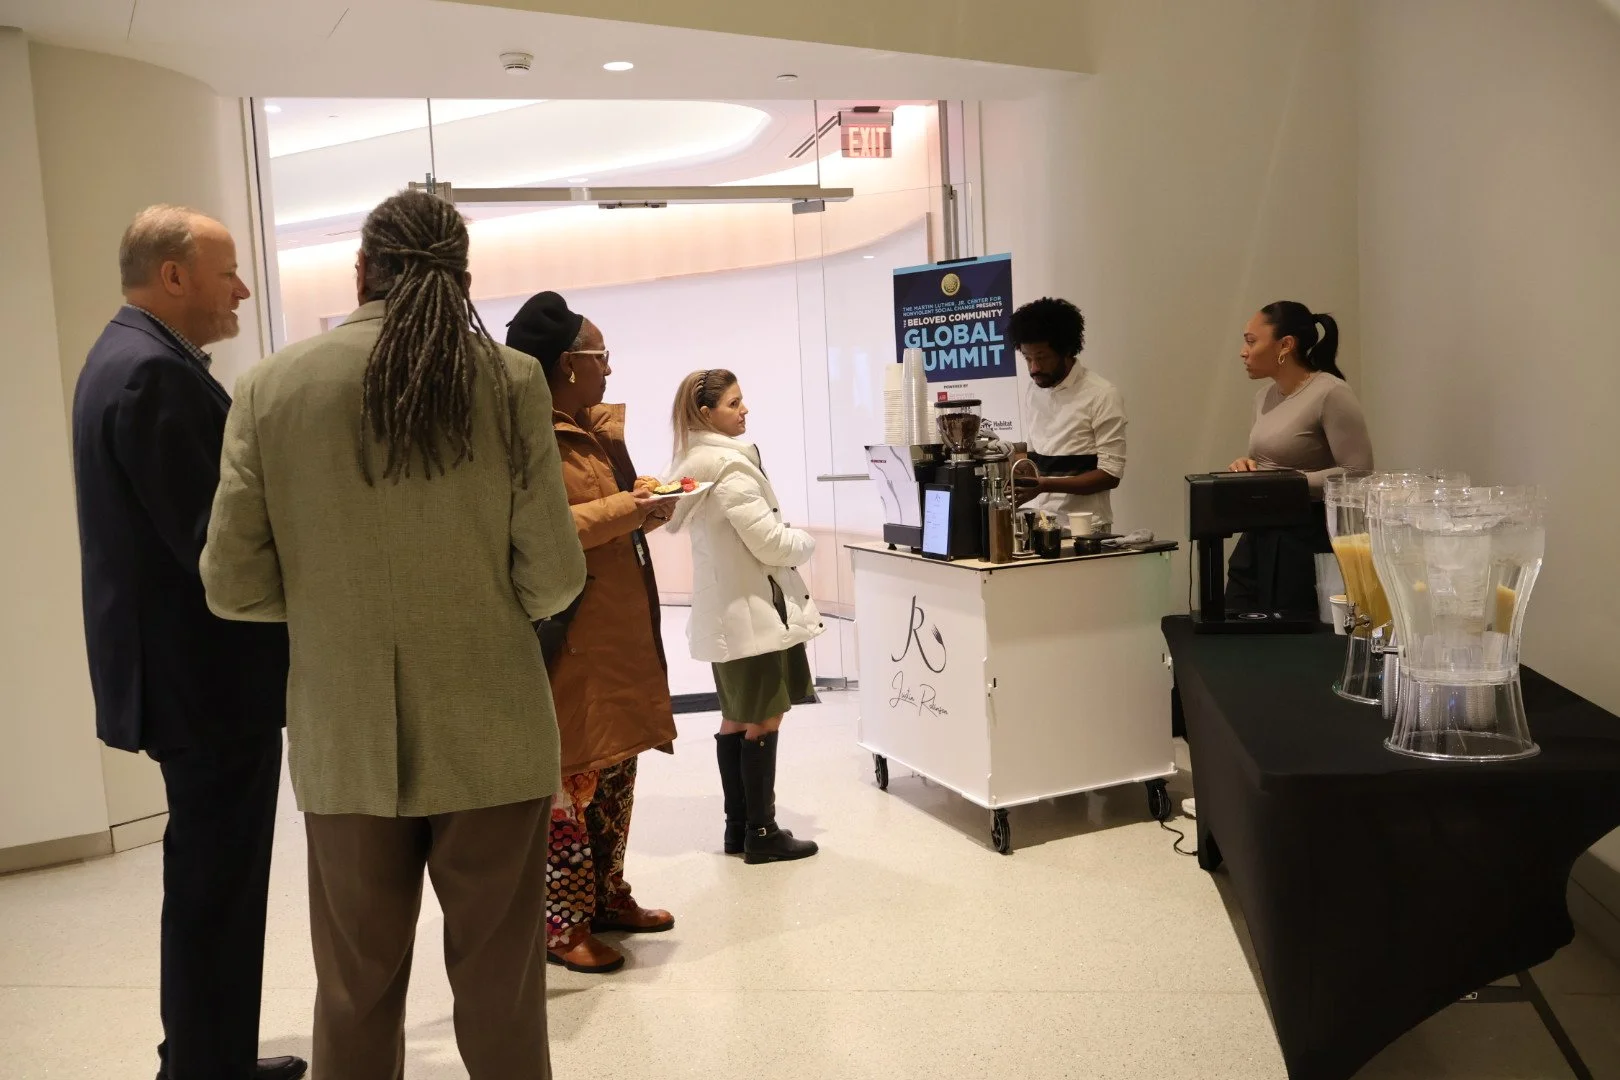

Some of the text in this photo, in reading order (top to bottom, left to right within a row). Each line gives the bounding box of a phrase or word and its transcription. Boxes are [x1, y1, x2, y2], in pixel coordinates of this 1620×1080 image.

[849, 127, 886, 157] EXIT
[908, 315, 947, 327] BELOVED
[948, 309, 1003, 322] COMMUNITY
[904, 321, 1004, 349] GLOBAL
[922, 344, 1005, 372] UMMIT
